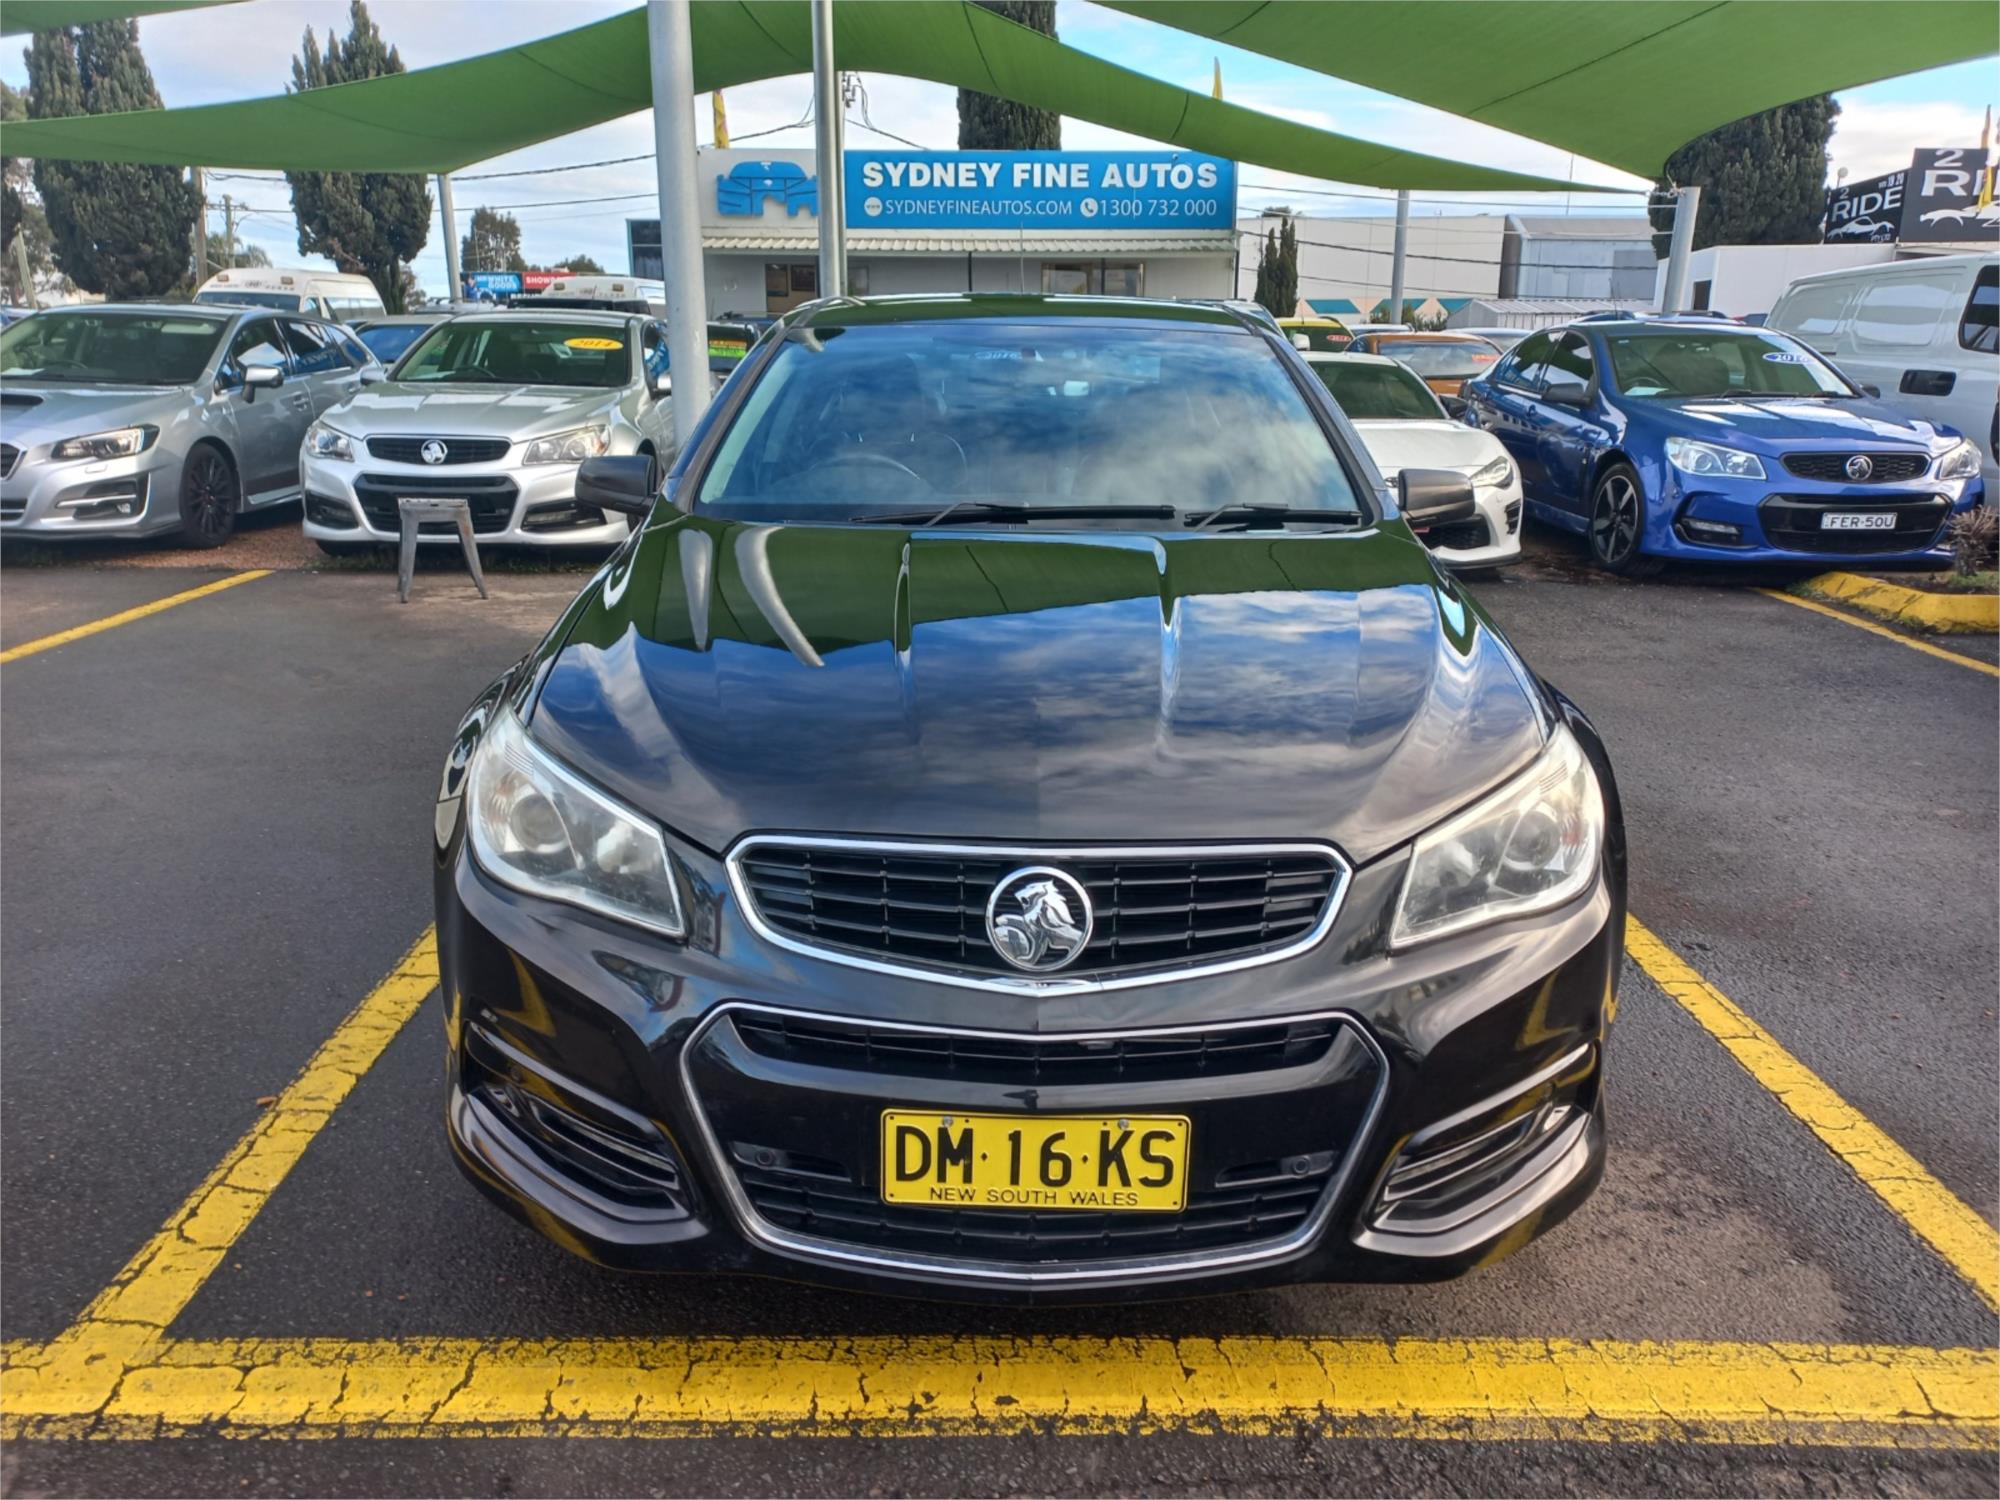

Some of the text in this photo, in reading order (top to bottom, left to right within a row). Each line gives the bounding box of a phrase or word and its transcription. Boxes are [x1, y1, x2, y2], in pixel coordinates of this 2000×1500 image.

[1933, 149, 1964, 167] 2
[863, 162, 1218, 190] SYDNEY FINE AUTOS
[1921, 169, 1999, 197] RI
[1839, 187, 1850, 199] 2
[886, 200, 1072, 215] SYDNEYFINEAUTOS.COM
[1101, 200, 1143, 216] 1300
[1148, 200, 1180, 216] 732
[1184, 200, 1218, 216] 000
[1831, 186, 1903, 222] RIDE
[930, 1187, 1138, 1206] NEW SOUTH WALES
